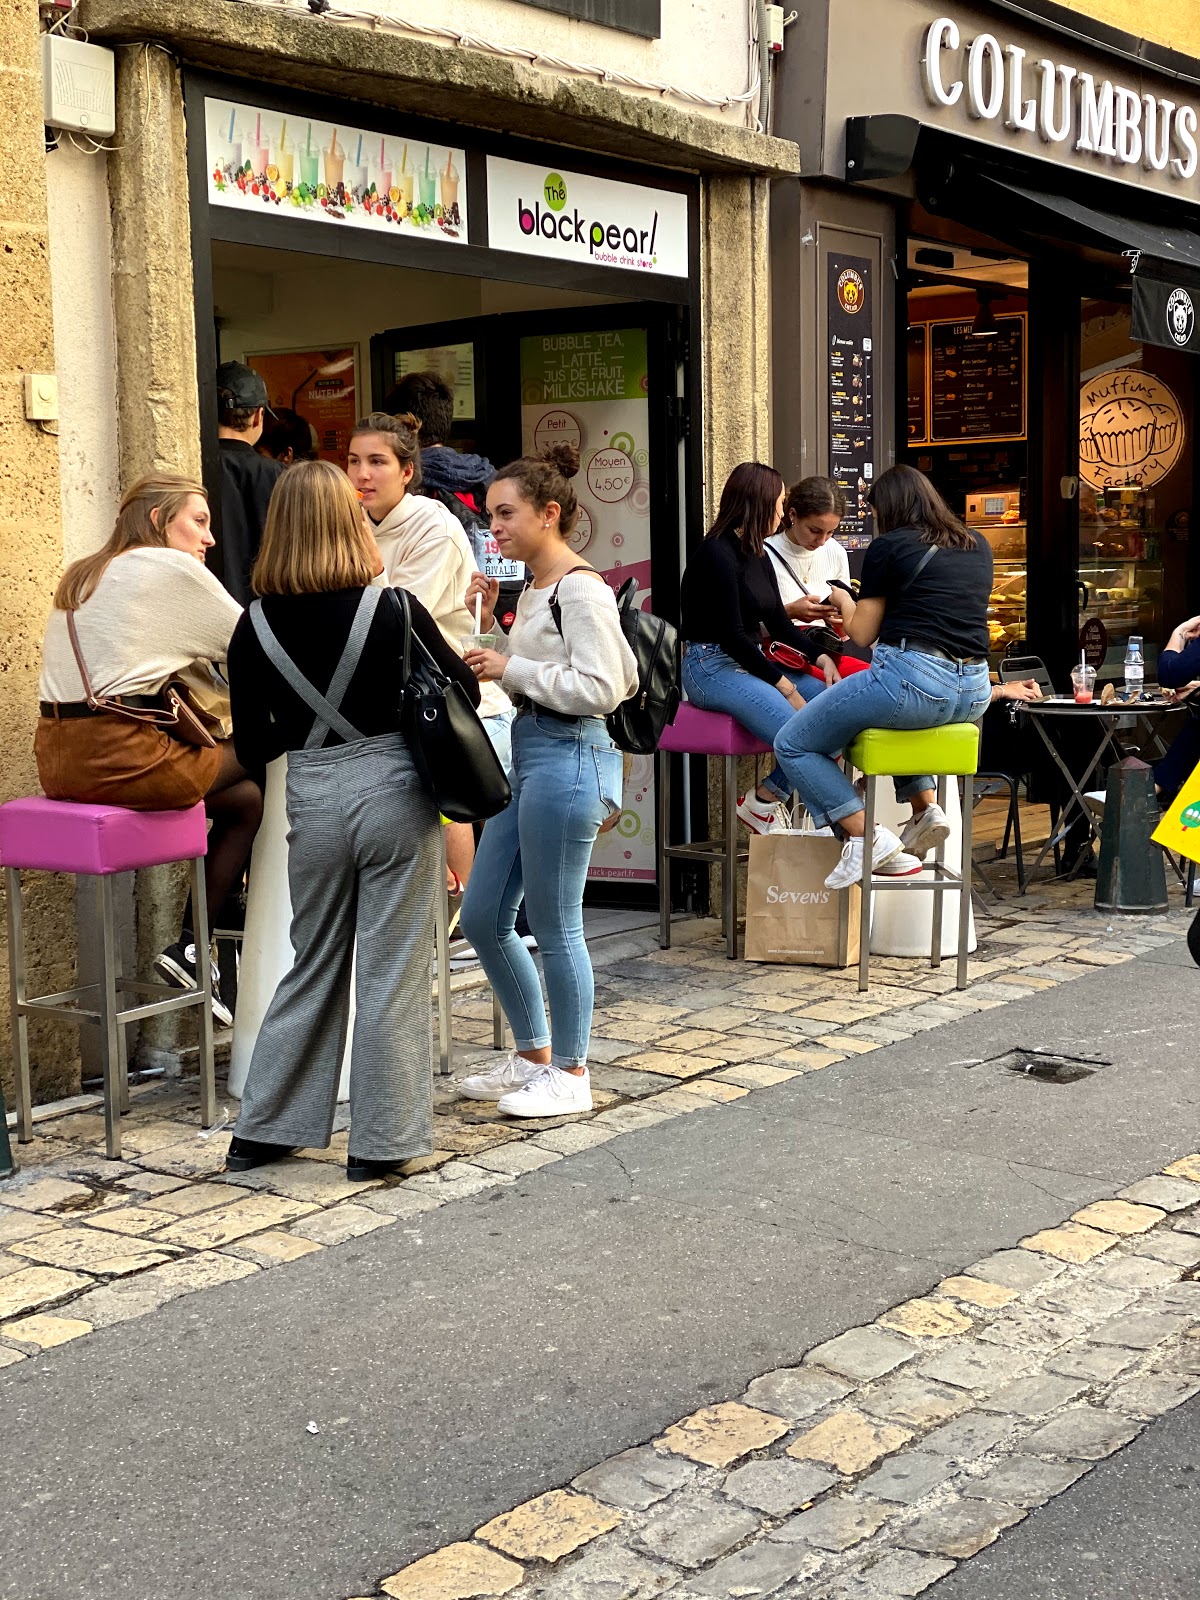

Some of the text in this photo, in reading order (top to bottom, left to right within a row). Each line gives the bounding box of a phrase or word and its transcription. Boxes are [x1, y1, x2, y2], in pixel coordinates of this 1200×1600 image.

[925, 18, 1198, 179] COLUMBUS
[518, 198, 586, 244] black
[594, 251, 653, 269] bubble drink store
[543, 335, 592, 352] BUBBLE
[543, 369, 567, 383] JUS
[570, 368, 587, 381] DE
[543, 379, 626, 399] MILKSHAKE
[1086, 375, 1157, 407] Muffins
[547, 419, 567, 429] Petit
[594, 457, 626, 469] Moyen
[595, 476, 630, 491] 4,50€
